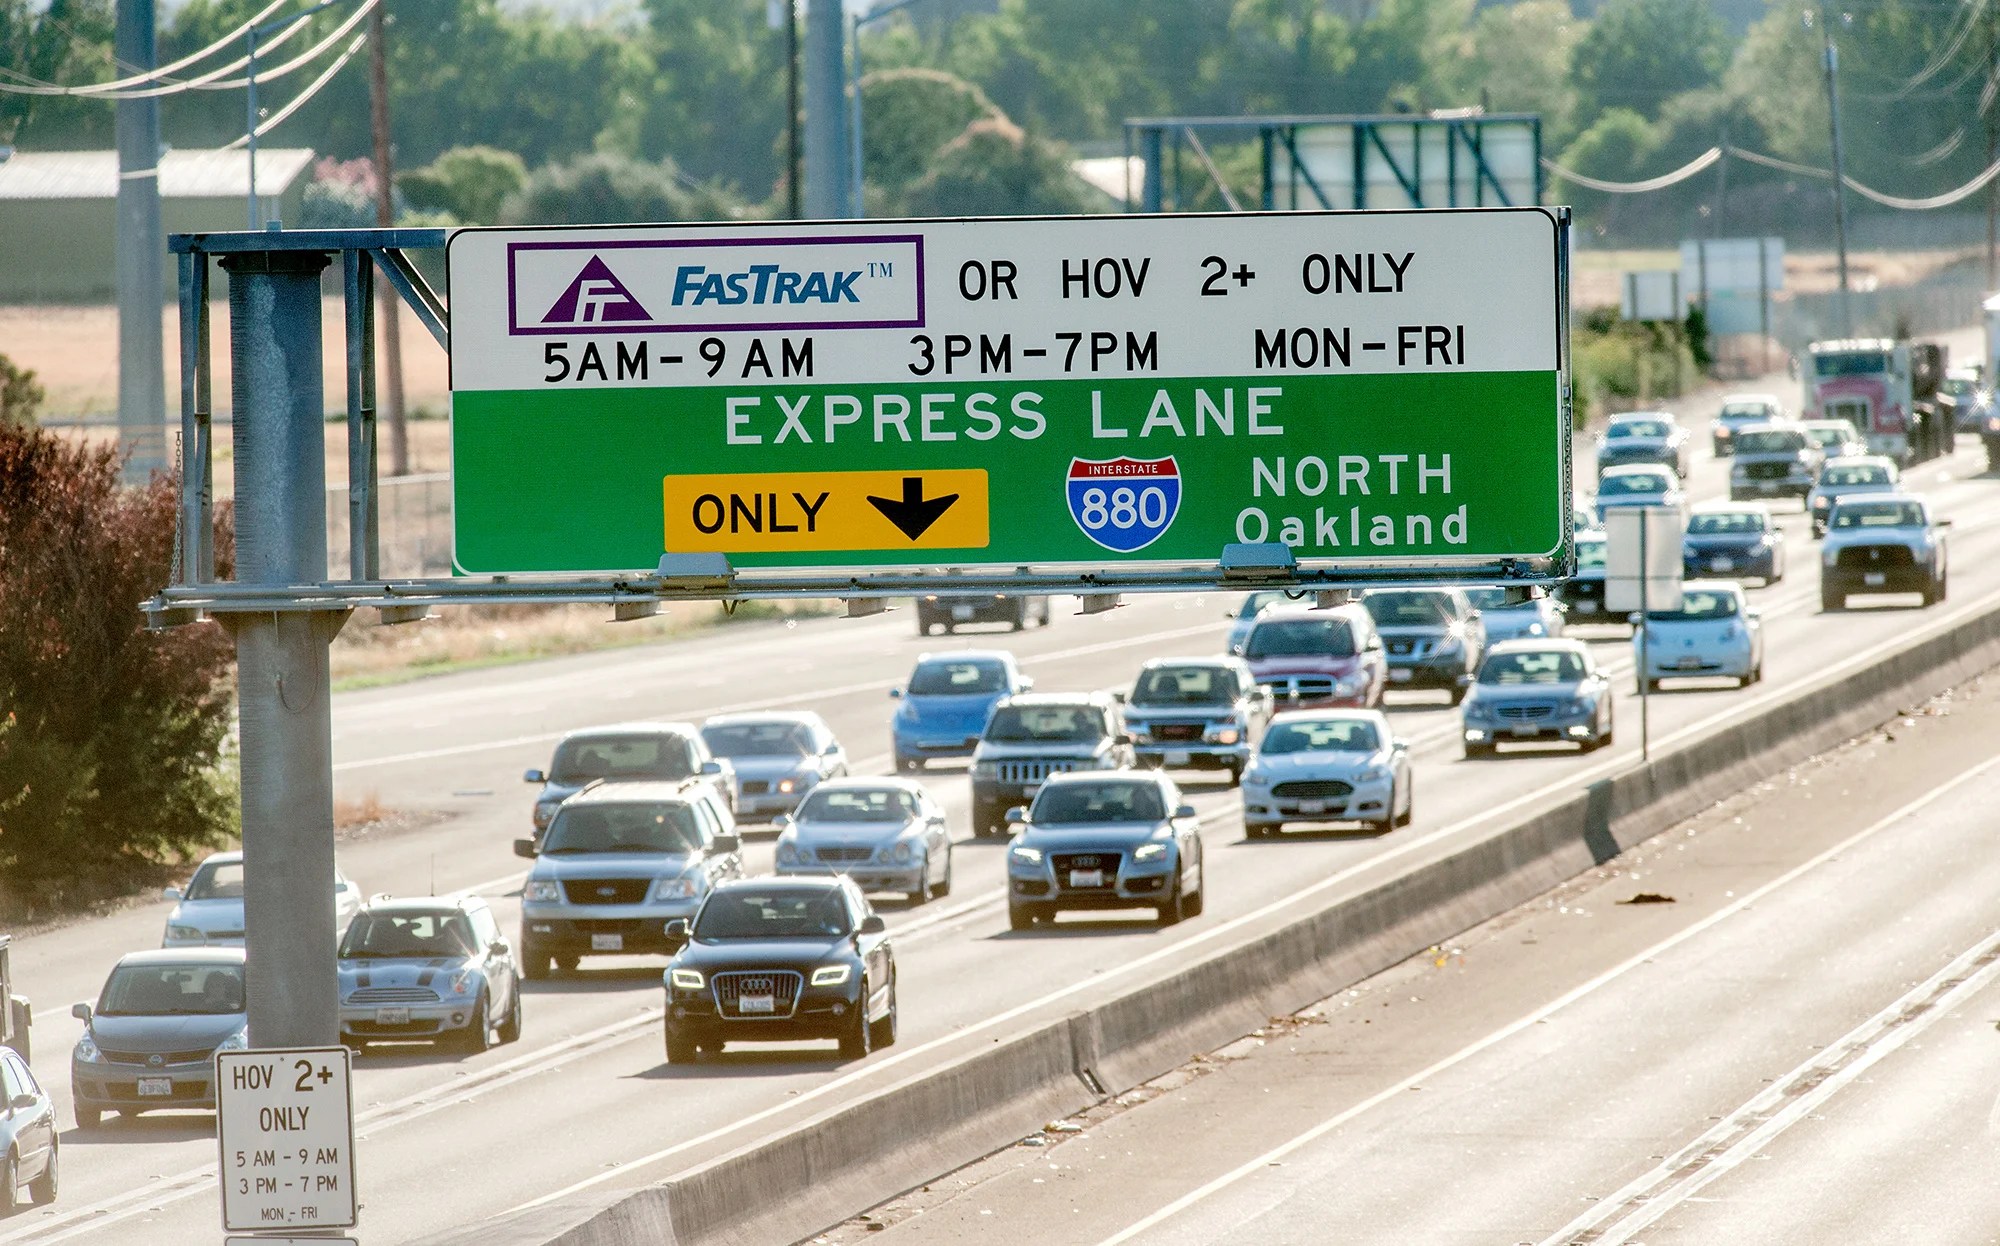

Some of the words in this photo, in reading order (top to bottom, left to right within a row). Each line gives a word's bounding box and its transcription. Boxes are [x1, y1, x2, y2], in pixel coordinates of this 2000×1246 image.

[958, 260, 1019, 302] OR
[1061, 257, 1151, 299] HOV
[1200, 255, 1256, 297] 2+
[1302, 252, 1415, 295] ONLY
[725, 391, 1047, 445] EXPRESS
[1091, 386, 1284, 439] LANE
[1086, 462, 1161, 477] INTERSTATE
[1252, 453, 1451, 497] NORTH
[692, 491, 830, 535] ONLY
[1079, 486, 1169, 531] 880
[1235, 503, 1468, 548] Oakland
[233, 1064, 274, 1090] HOV
[294, 1059, 334, 1093] 2+
[259, 1106, 310, 1132] ONLY
[236, 1150, 246, 1168] 5
[253, 1149, 276, 1167] AM
[315, 1147, 338, 1165] AM
[239, 1177, 249, 1195] 3
[255, 1176, 277, 1194] PM
[316, 1174, 338, 1192] PM
[261, 1207, 284, 1221] MON
[301, 1206, 318, 1219] FRI
